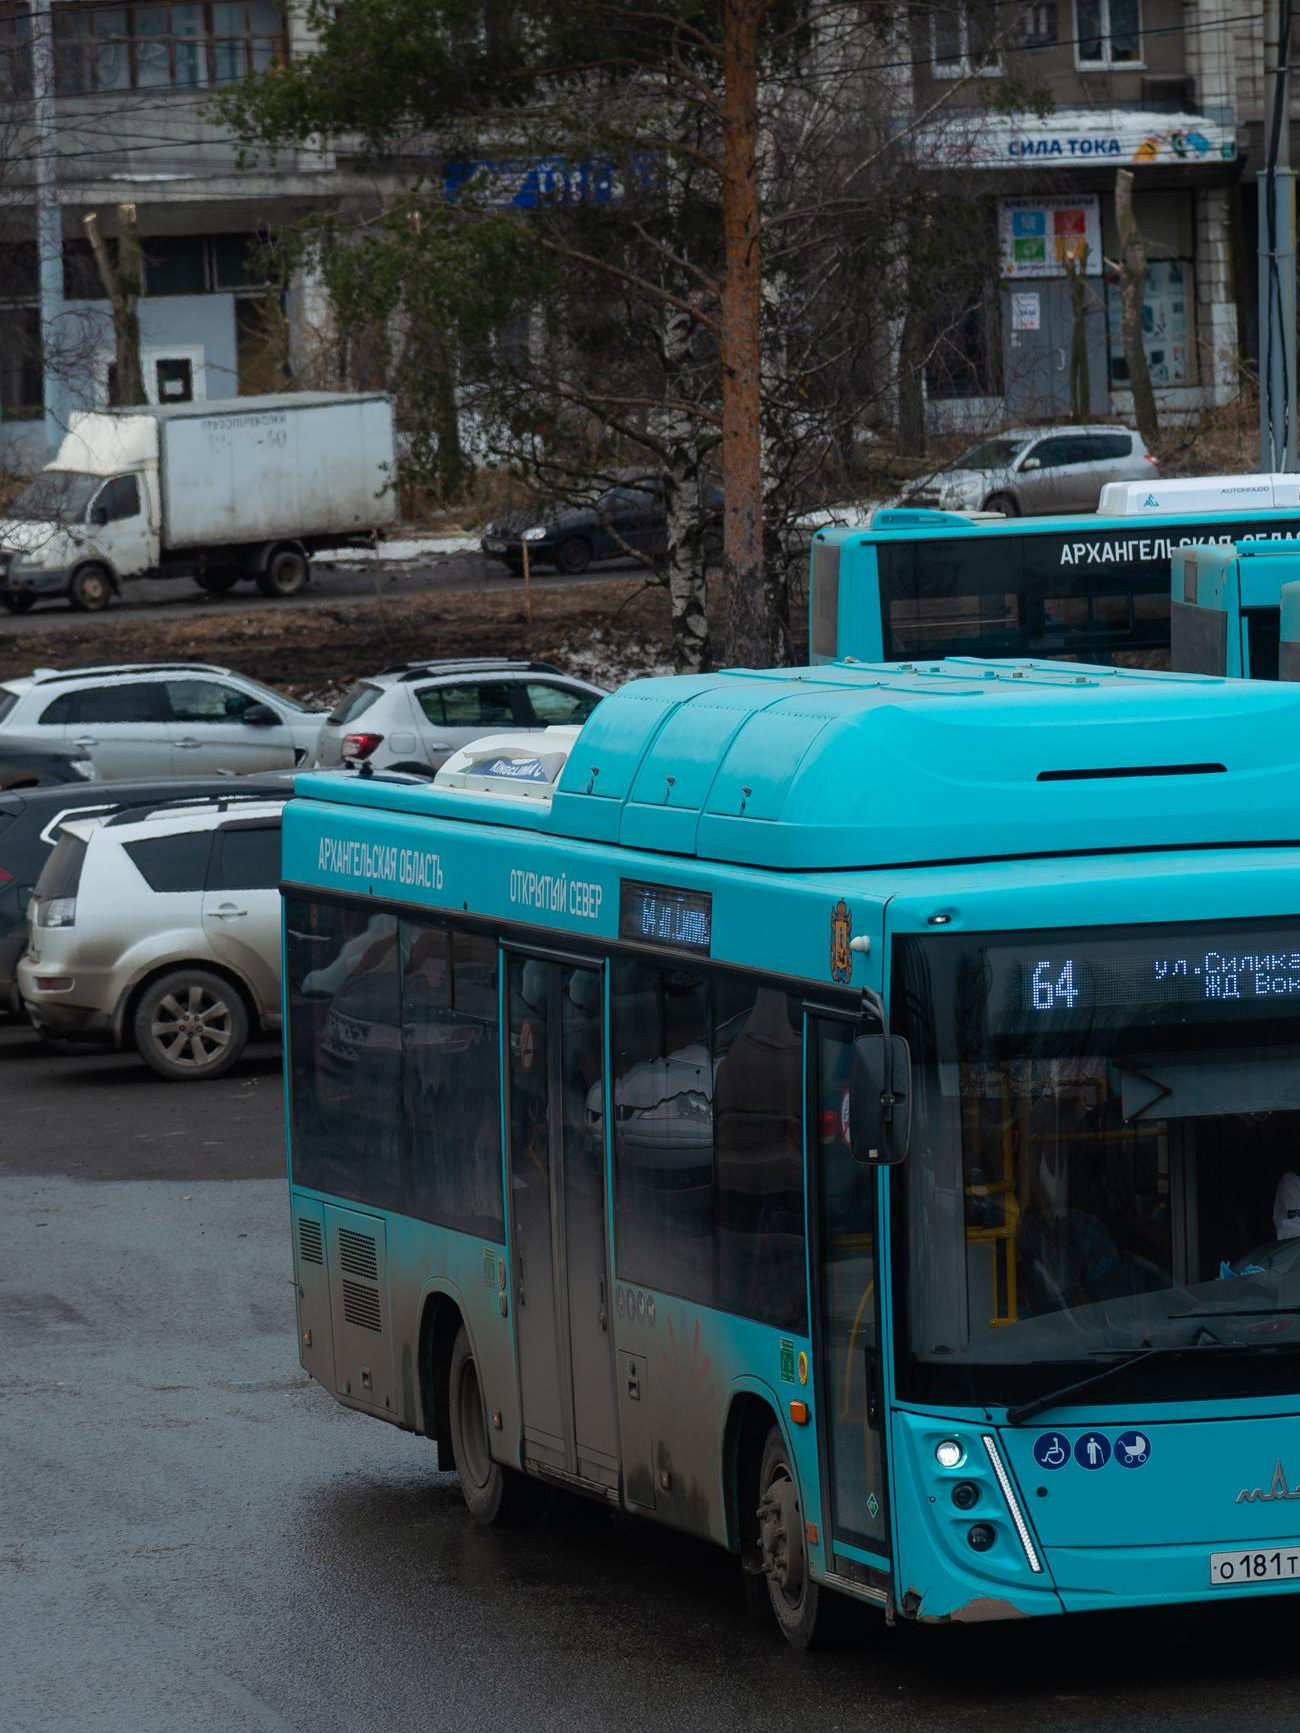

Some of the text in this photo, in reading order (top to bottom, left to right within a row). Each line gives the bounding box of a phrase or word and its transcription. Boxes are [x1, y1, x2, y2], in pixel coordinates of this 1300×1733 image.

[1008, 138, 1063, 156] СИЛА
[1067, 138, 1122, 156] ТОКА
[489, 759, 536, 776] KINGCLIMA
[317, 837, 443, 891] АРХАНГЕЛЬСКАЯ ОБЛАСТЬ
[509, 868, 567, 913] ОТКРЫТЫЙ
[569, 881, 602, 918] СЕВЕР
[1031, 959, 1079, 1010] 64
[1205, 973, 1240, 999] ЖД
